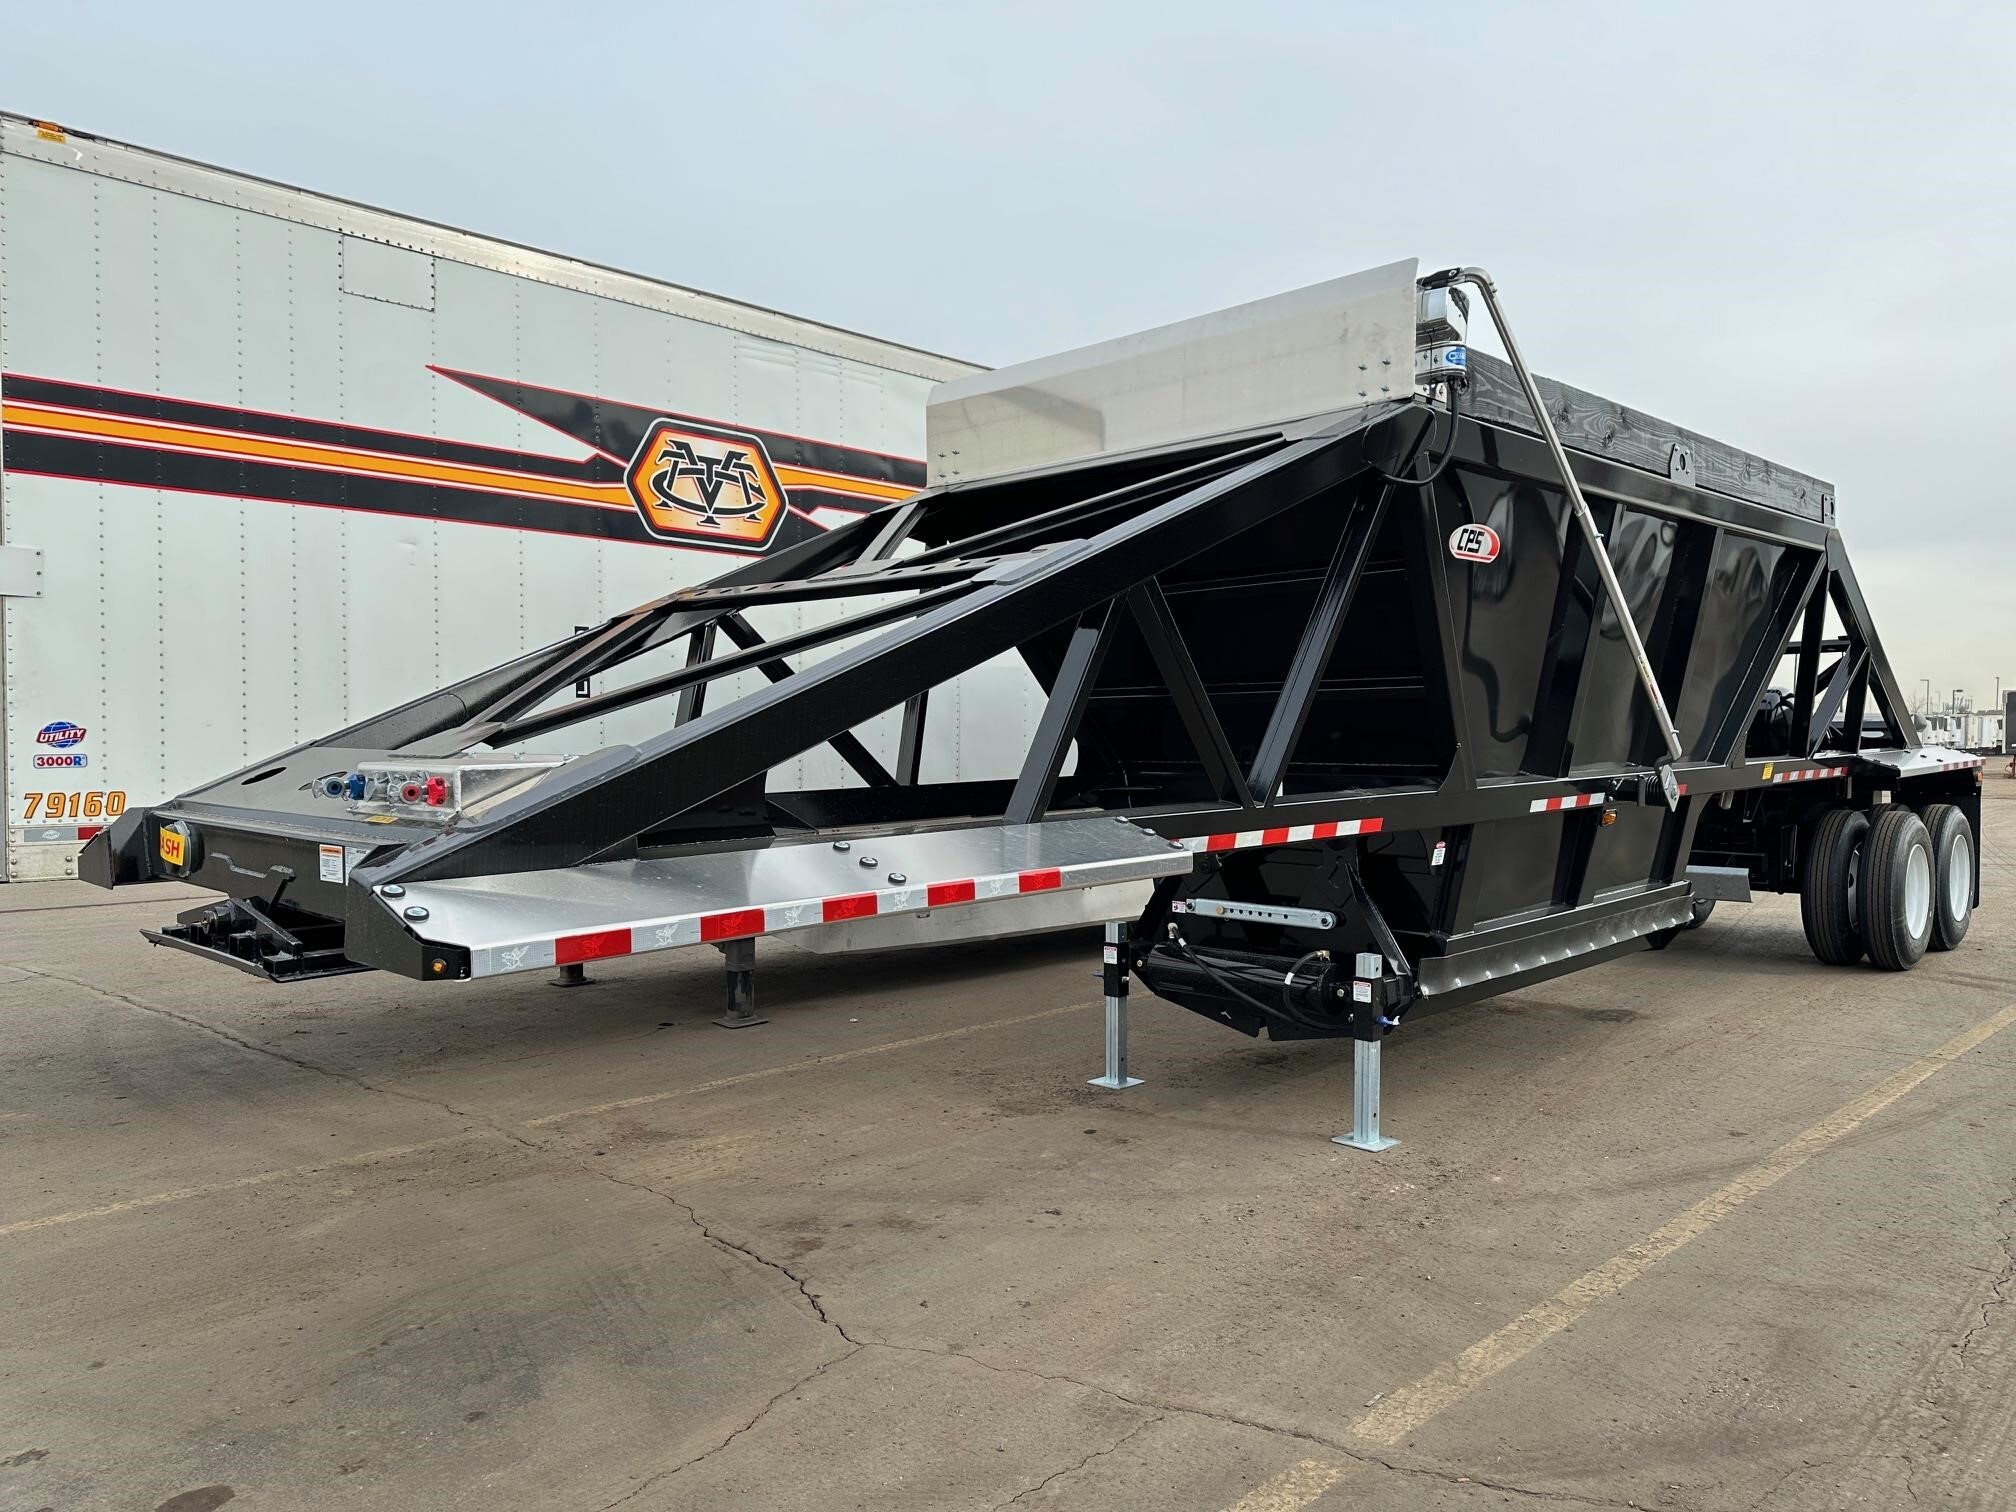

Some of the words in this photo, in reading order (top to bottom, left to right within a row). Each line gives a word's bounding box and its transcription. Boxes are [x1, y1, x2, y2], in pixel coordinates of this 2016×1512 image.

[1456, 528, 1485, 553] CPS
[39, 729, 84, 743] UTILITY
[24, 791, 126, 819] 79160
